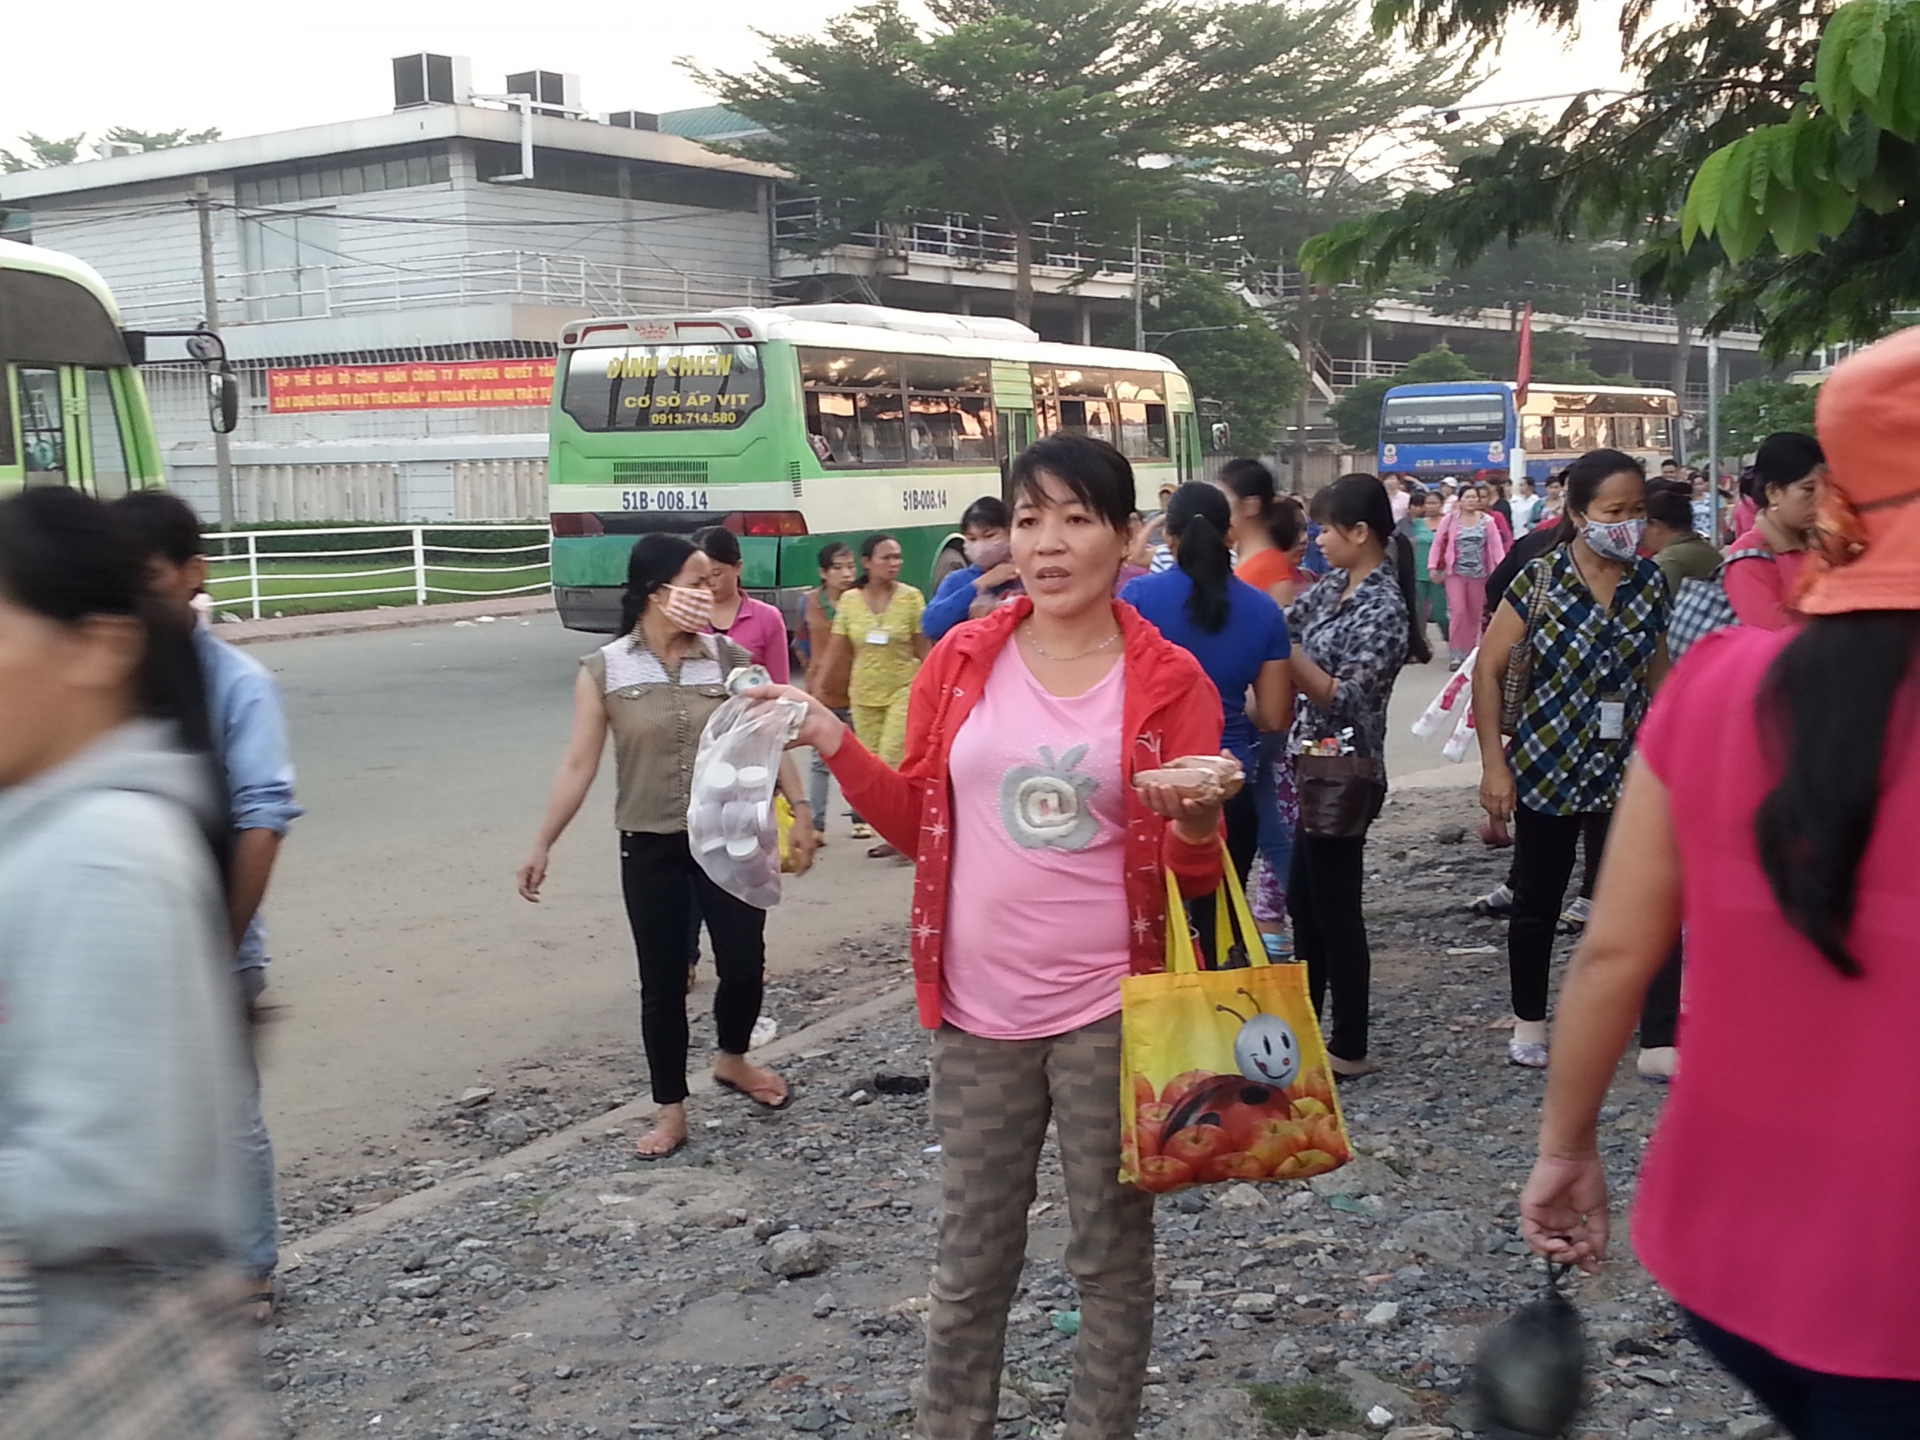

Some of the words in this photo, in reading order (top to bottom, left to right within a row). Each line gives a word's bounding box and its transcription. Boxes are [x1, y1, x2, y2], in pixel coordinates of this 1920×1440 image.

[441, 368, 454, 381] TY
[624, 393, 651, 409] CƠ
[655, 390, 681, 408] SỞ
[716, 393, 750, 410] VỊT
[651, 412, 737, 425] 0913.714.580
[622, 490, 709, 511] 51B-008.14
[903, 489, 947, 511] 51B-008.14
